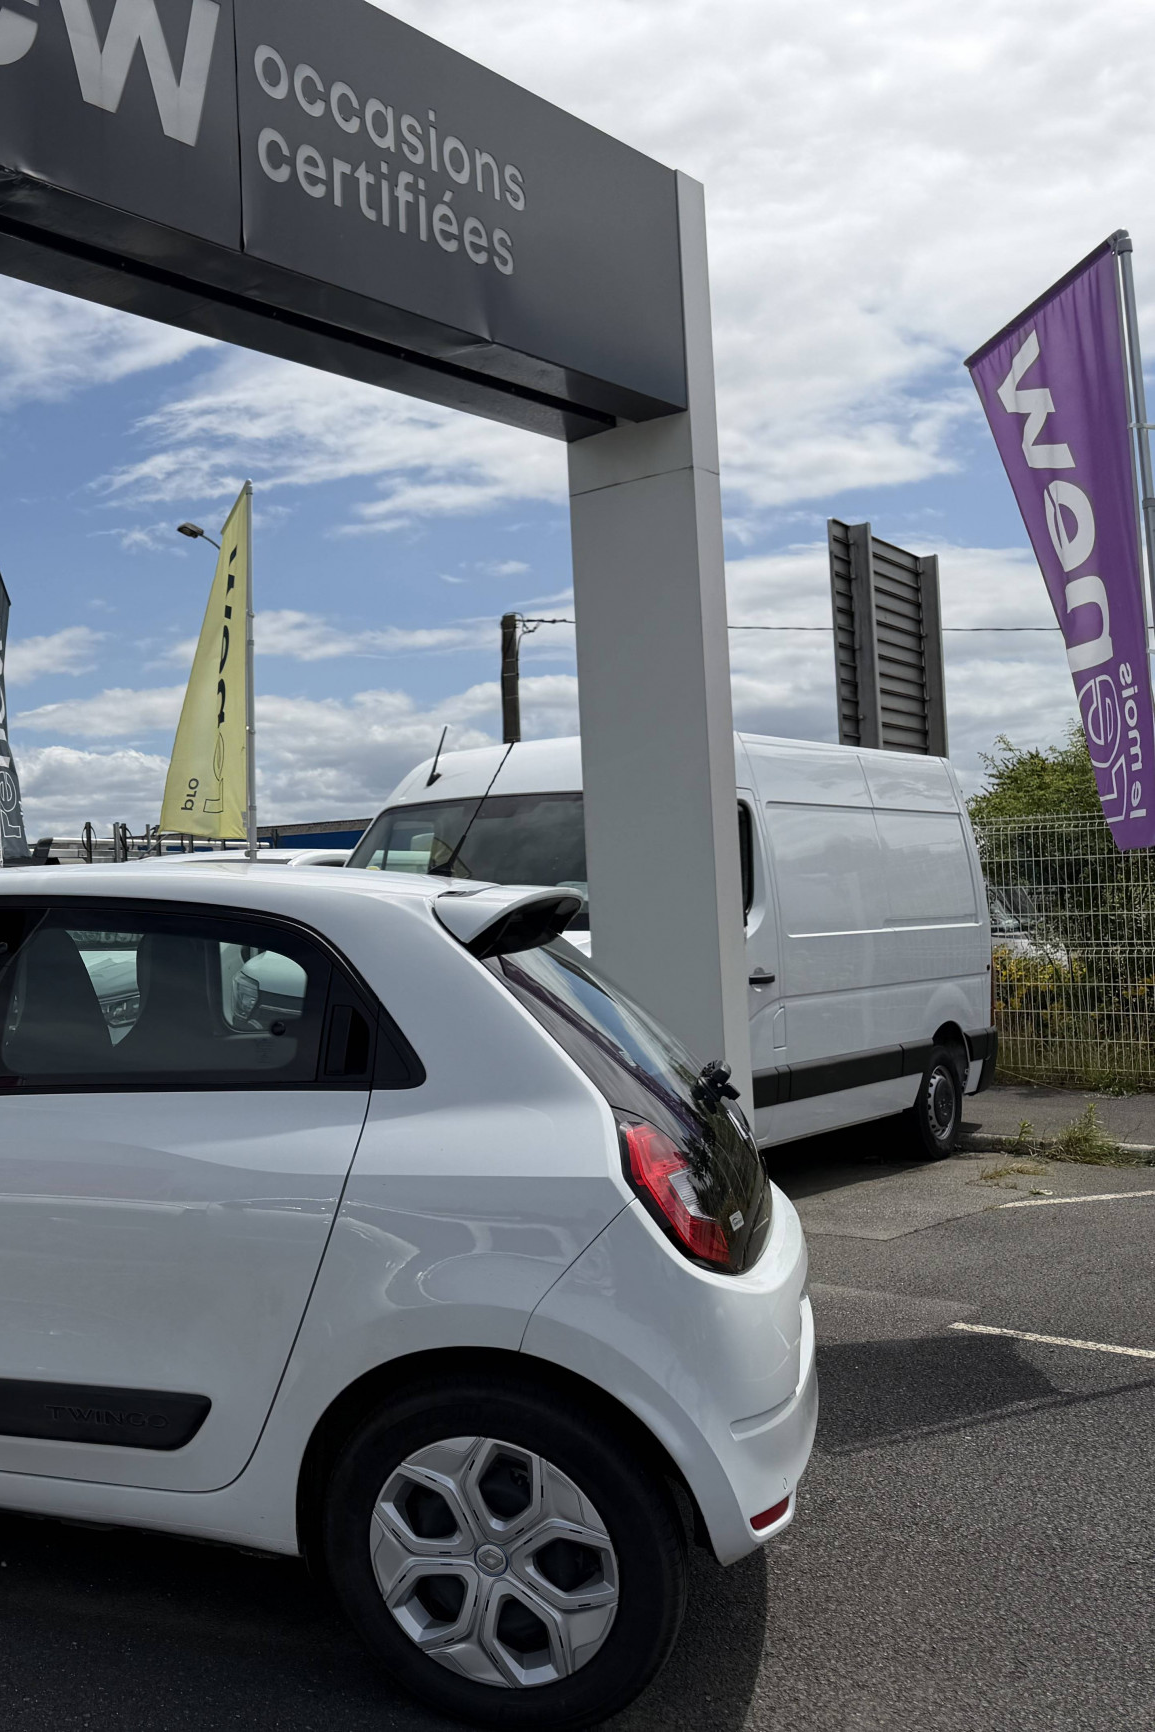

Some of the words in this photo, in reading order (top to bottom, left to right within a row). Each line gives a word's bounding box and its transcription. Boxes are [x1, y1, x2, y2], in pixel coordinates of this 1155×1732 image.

[253, 43, 526, 212] occasions
[256, 126, 515, 276] certifiées
[45, 1404, 170, 1429] TWINGO
